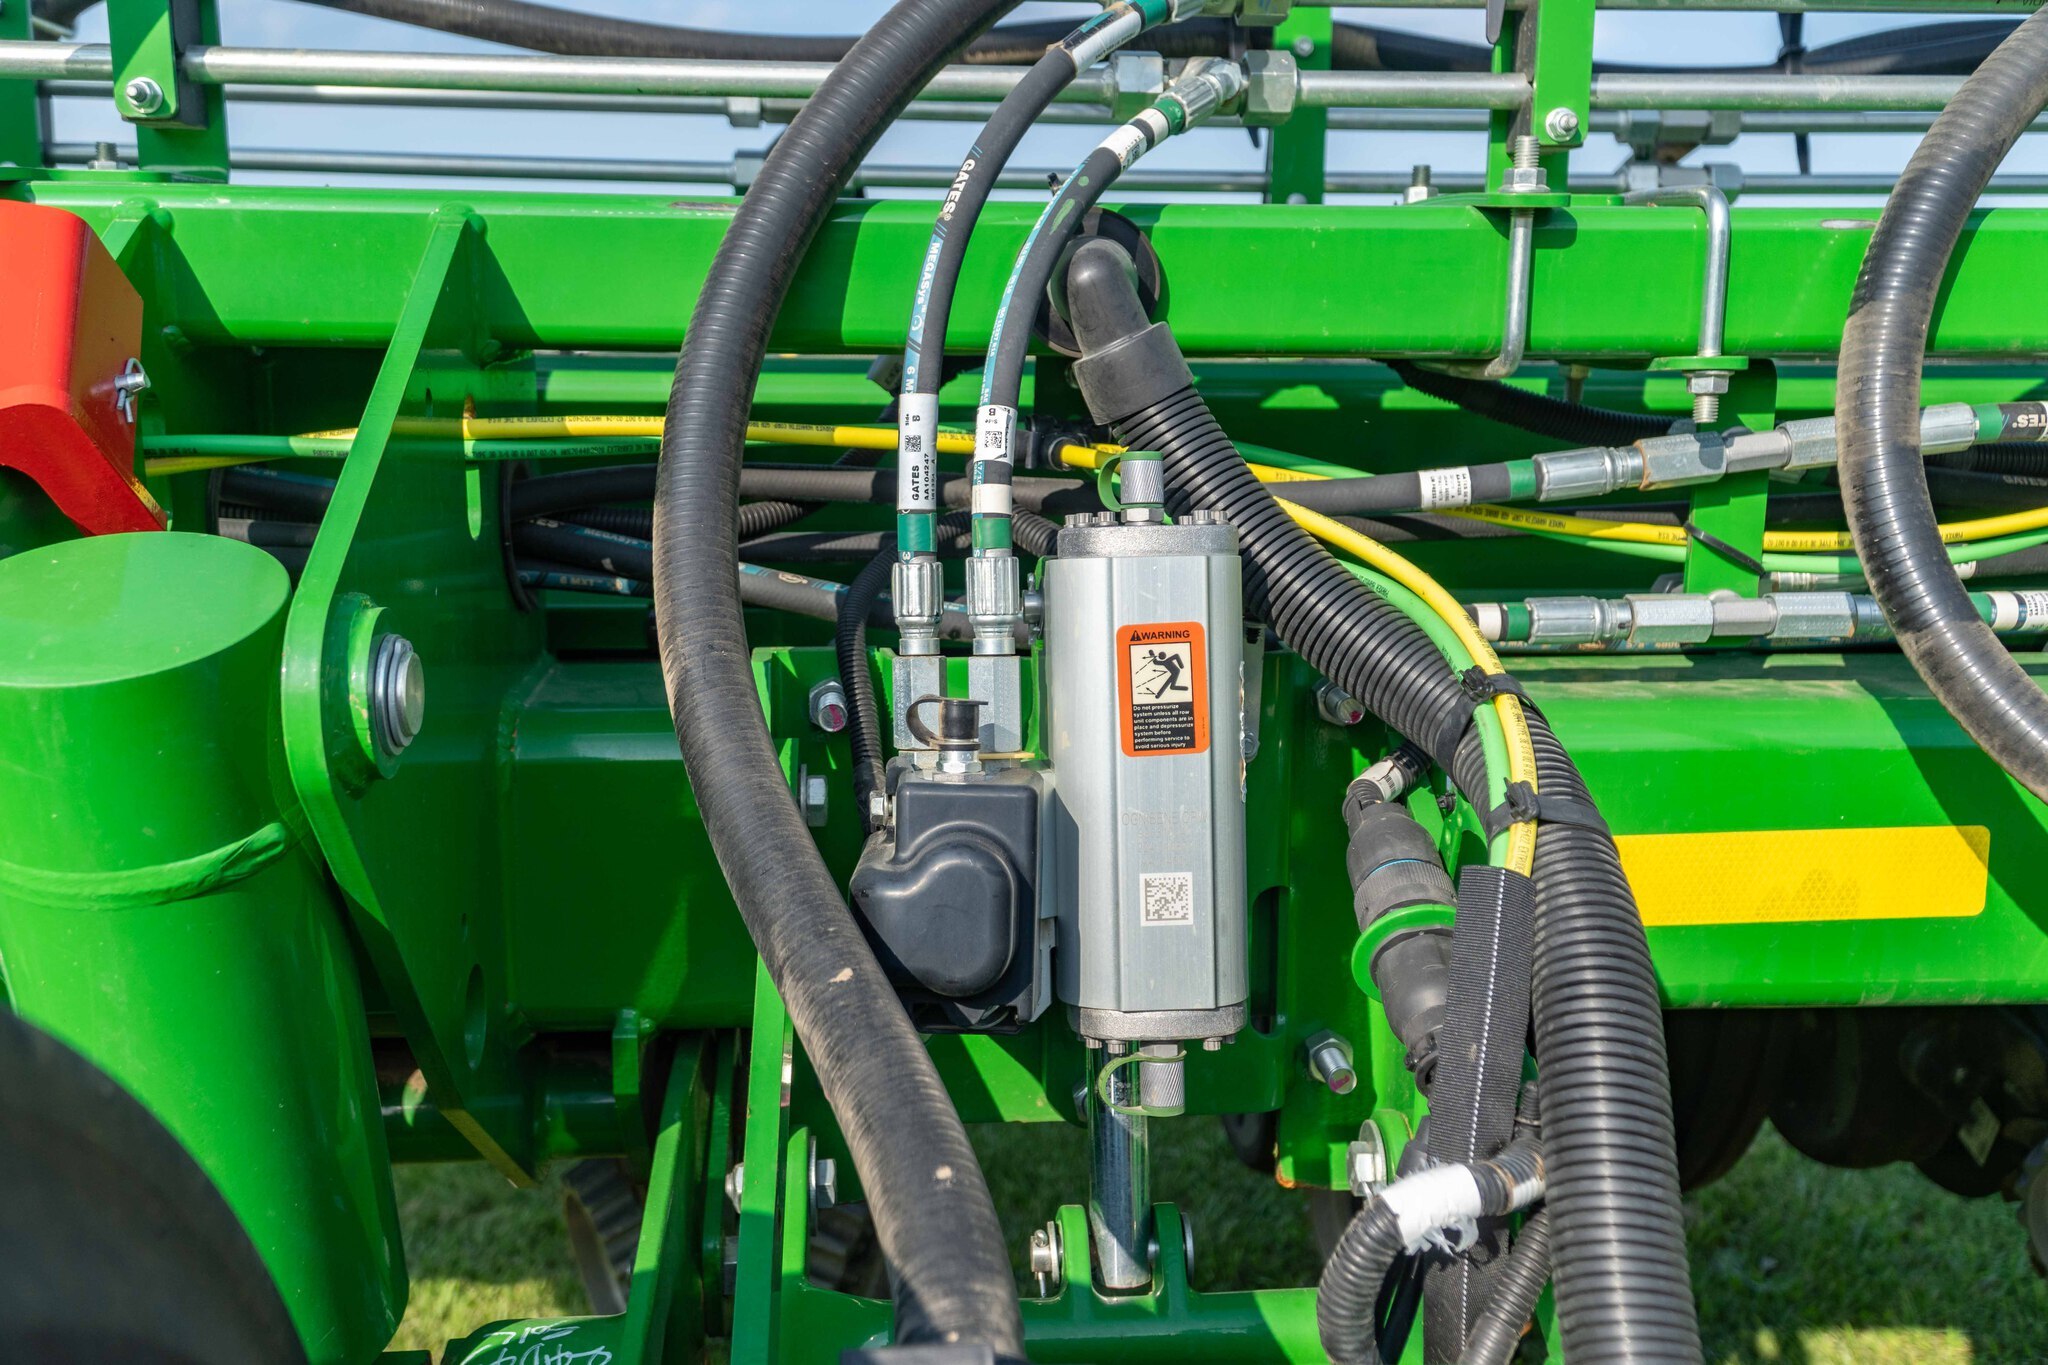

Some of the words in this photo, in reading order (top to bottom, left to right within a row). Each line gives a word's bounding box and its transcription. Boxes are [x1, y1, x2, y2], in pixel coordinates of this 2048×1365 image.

[906, 366, 915, 375] 6
[989, 408, 996, 416] B
[912, 465, 920, 500] GATES
[1141, 630, 1190, 640] WARNING
